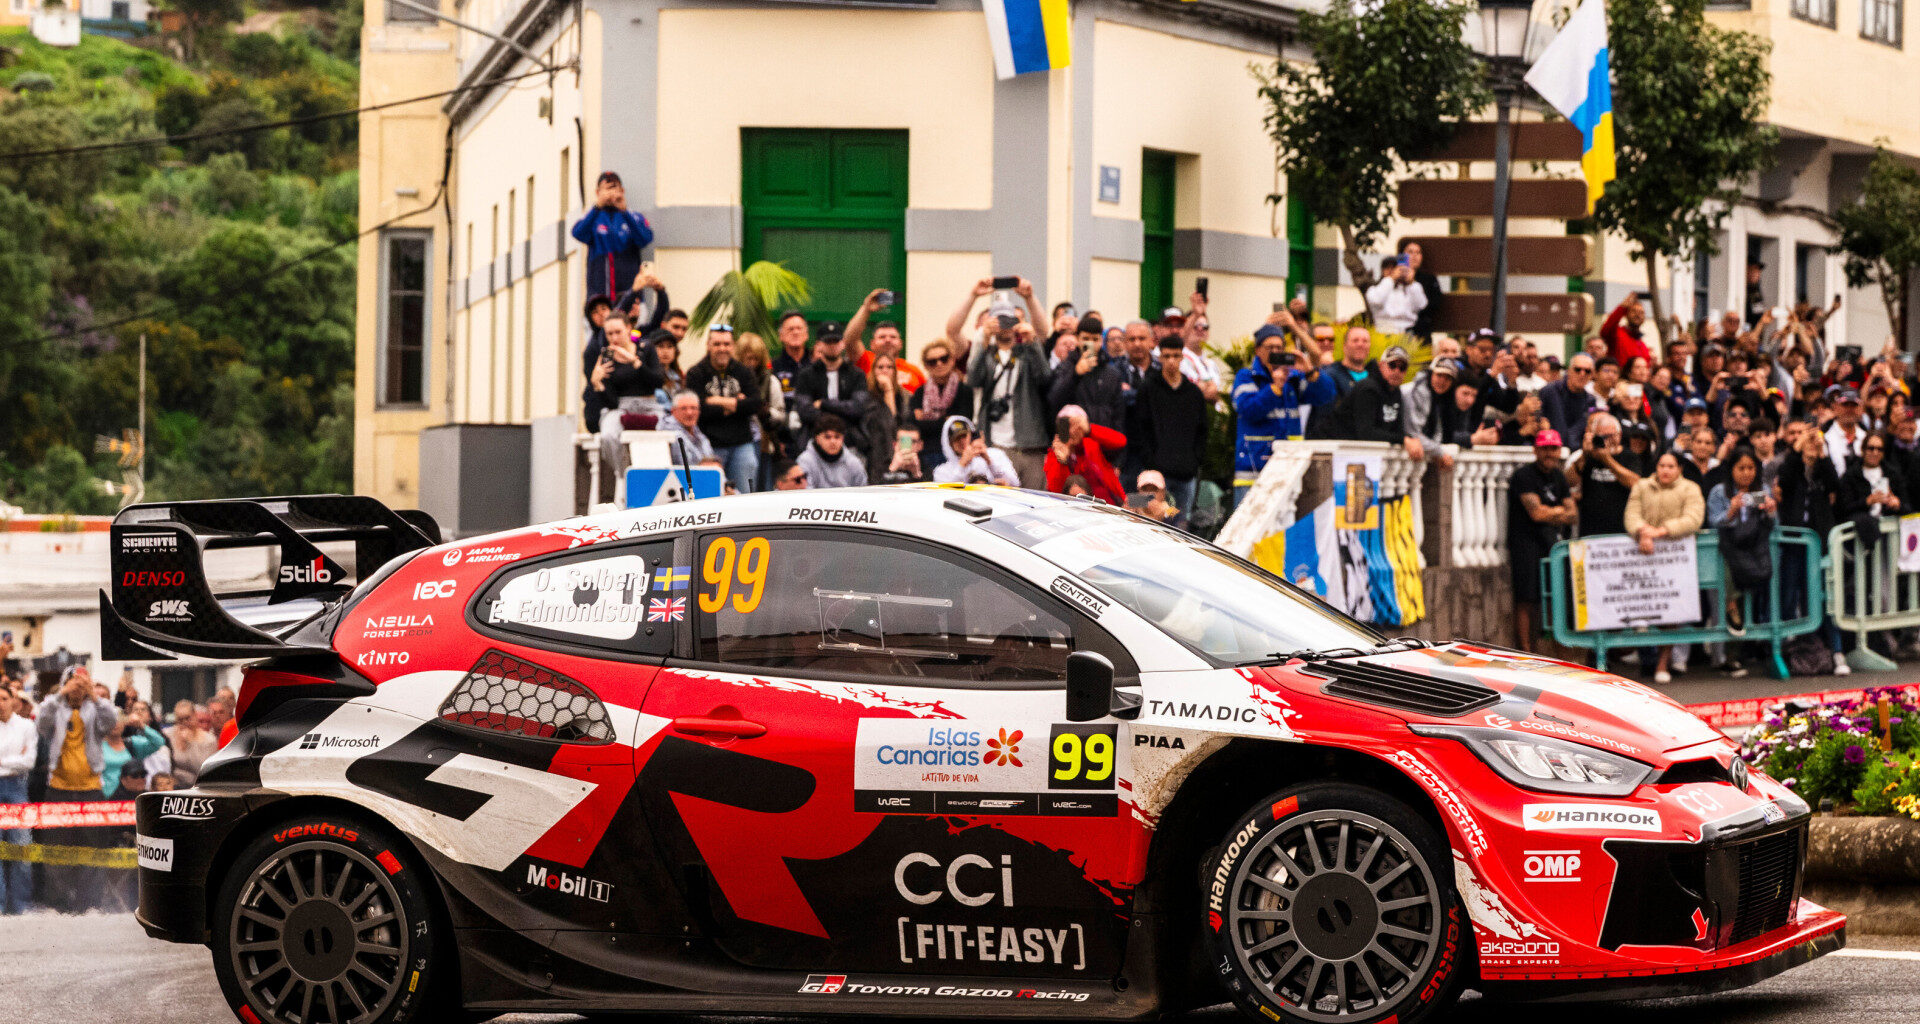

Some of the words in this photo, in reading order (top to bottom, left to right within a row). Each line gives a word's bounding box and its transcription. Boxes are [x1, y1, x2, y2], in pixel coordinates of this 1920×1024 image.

[629, 512, 722, 533] AsahiKASEI
[788, 508, 879, 524] PROTERIAL
[122, 537, 177, 548] SCHROTH
[466, 547, 504, 556] JAPAN
[280, 554, 332, 583] Stilo
[465, 553, 521, 563] AIRLINES
[122, 571, 185, 587] DENSO
[535, 569, 556, 593] O.
[566, 568, 650, 596] Solberg
[698, 537, 770, 614] 99
[1052, 577, 1105, 616] CENTRAL
[149, 600, 194, 617] SWS
[489, 600, 510, 624] E.
[519, 598, 645, 623] Edmondson
[1149, 700, 1257, 723] TAMADIC
[322, 734, 380, 748] Microsoft
[929, 727, 980, 747] Islas
[1134, 734, 1186, 749] PIAA
[1519, 719, 1640, 754] codebeamer
[877, 745, 980, 767] Canarias
[1053, 733, 1114, 781] 99
[952, 773, 962, 782] DE
[963, 773, 979, 783] VIDA
[161, 796, 216, 816] ENDLESS
[877, 797, 911, 806] WRC
[1384, 753, 1483, 858] AUTOMOTIVE
[1396, 749, 1489, 850] Panasonic
[1523, 855, 1581, 876] OMP
[526, 864, 587, 897] Mobil
[1480, 942, 1560, 954] akebono
[801, 979, 842, 993] GR
[847, 983, 929, 996] TOYOTA
[934, 985, 1014, 998] GAZOO
[1016, 988, 1091, 1002] Racing
